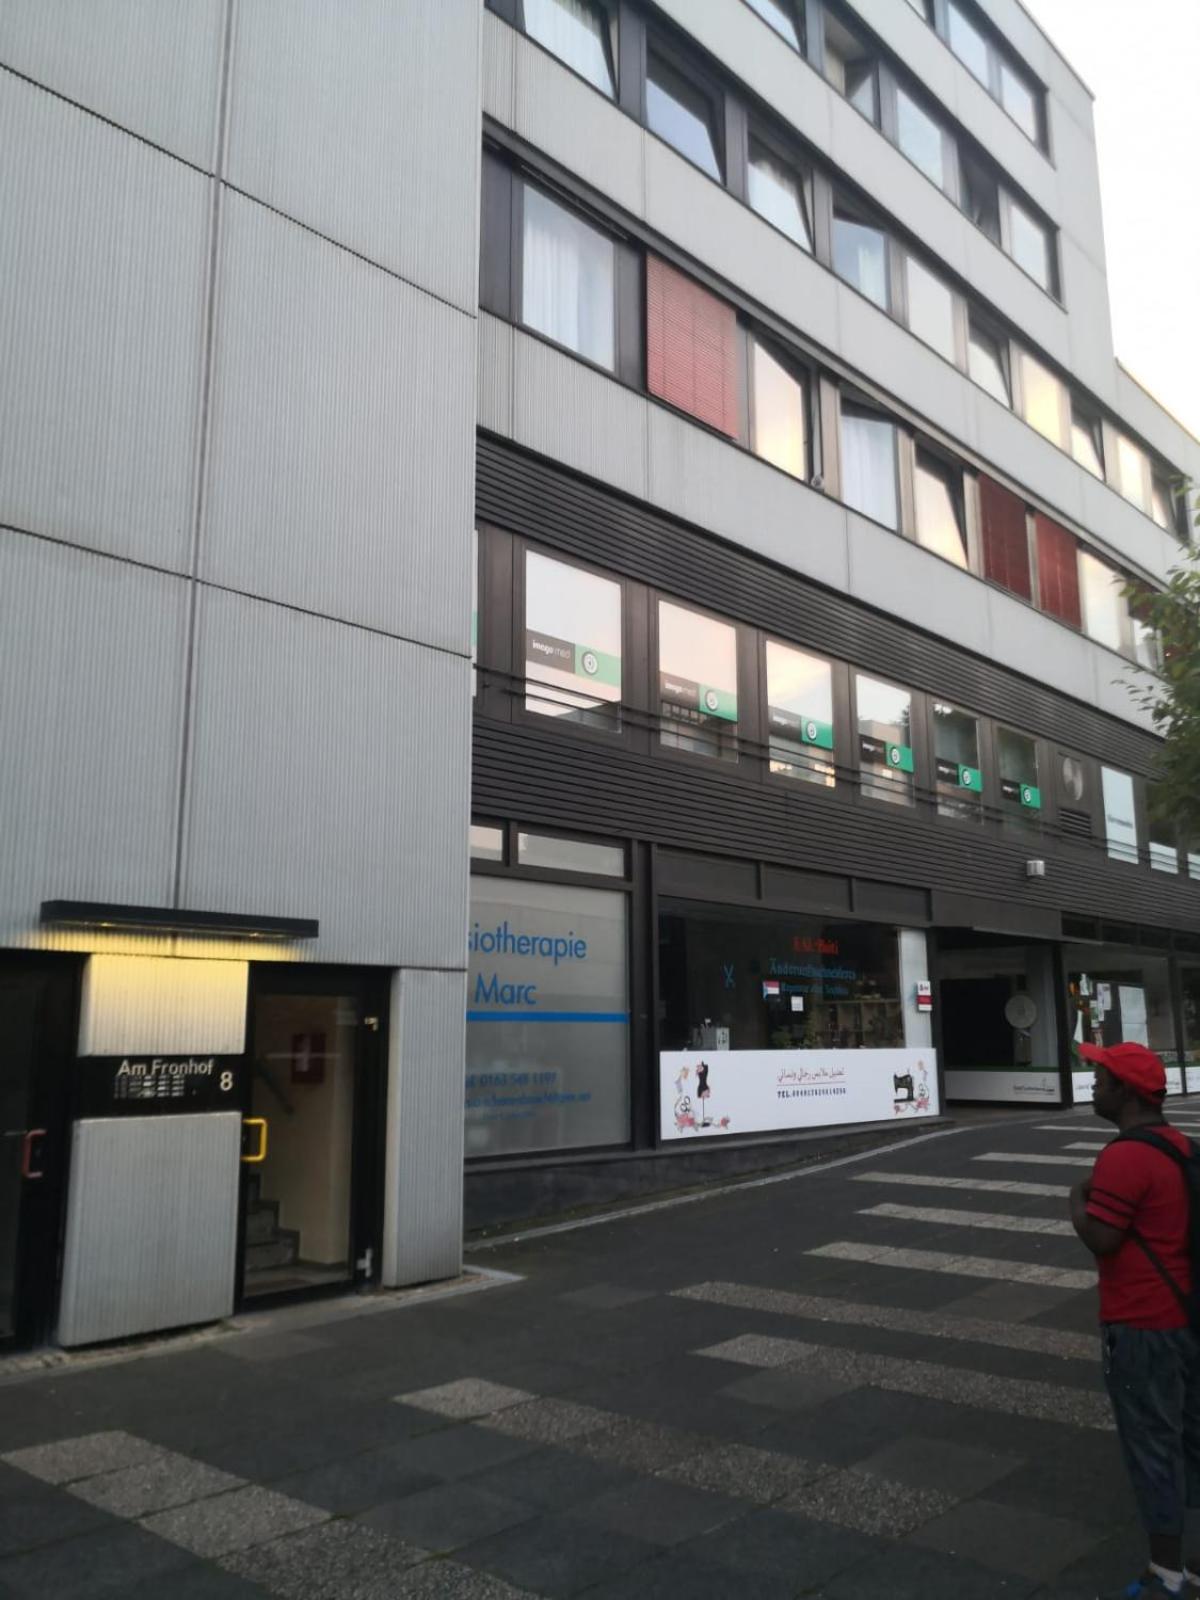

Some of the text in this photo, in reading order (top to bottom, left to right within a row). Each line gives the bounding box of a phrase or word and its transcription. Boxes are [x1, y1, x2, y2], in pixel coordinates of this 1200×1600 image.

[474, 972, 537, 1005] Marc
[117, 1058, 233, 1091] Am Fronhof 8
